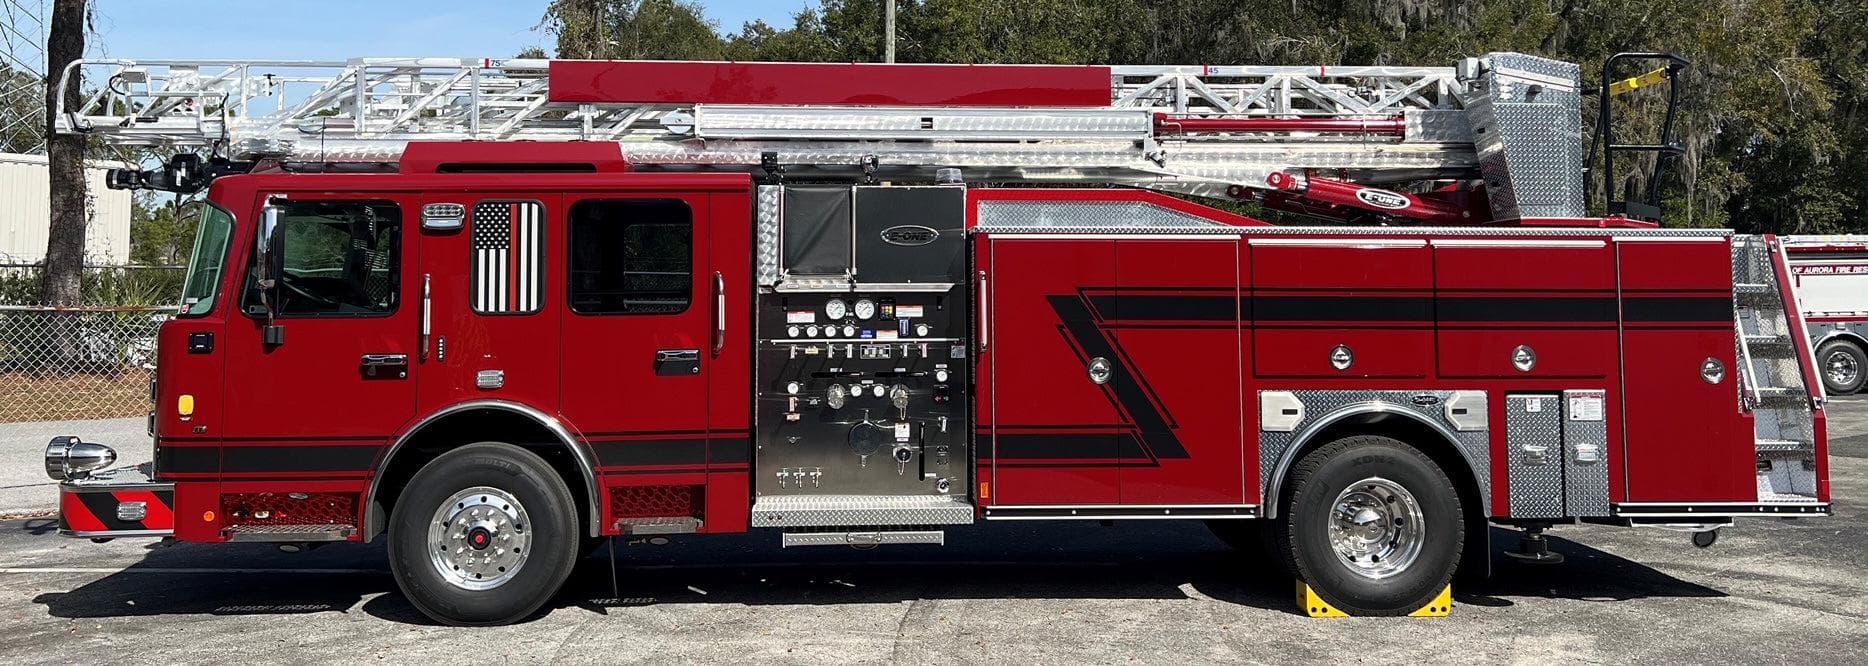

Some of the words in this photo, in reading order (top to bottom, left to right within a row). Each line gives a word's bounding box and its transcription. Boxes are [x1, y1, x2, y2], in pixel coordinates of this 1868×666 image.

[1364, 192, 1402, 206] E-ONE
[889, 231, 930, 241] E-ONE
[1804, 266, 1833, 274] AURORA
